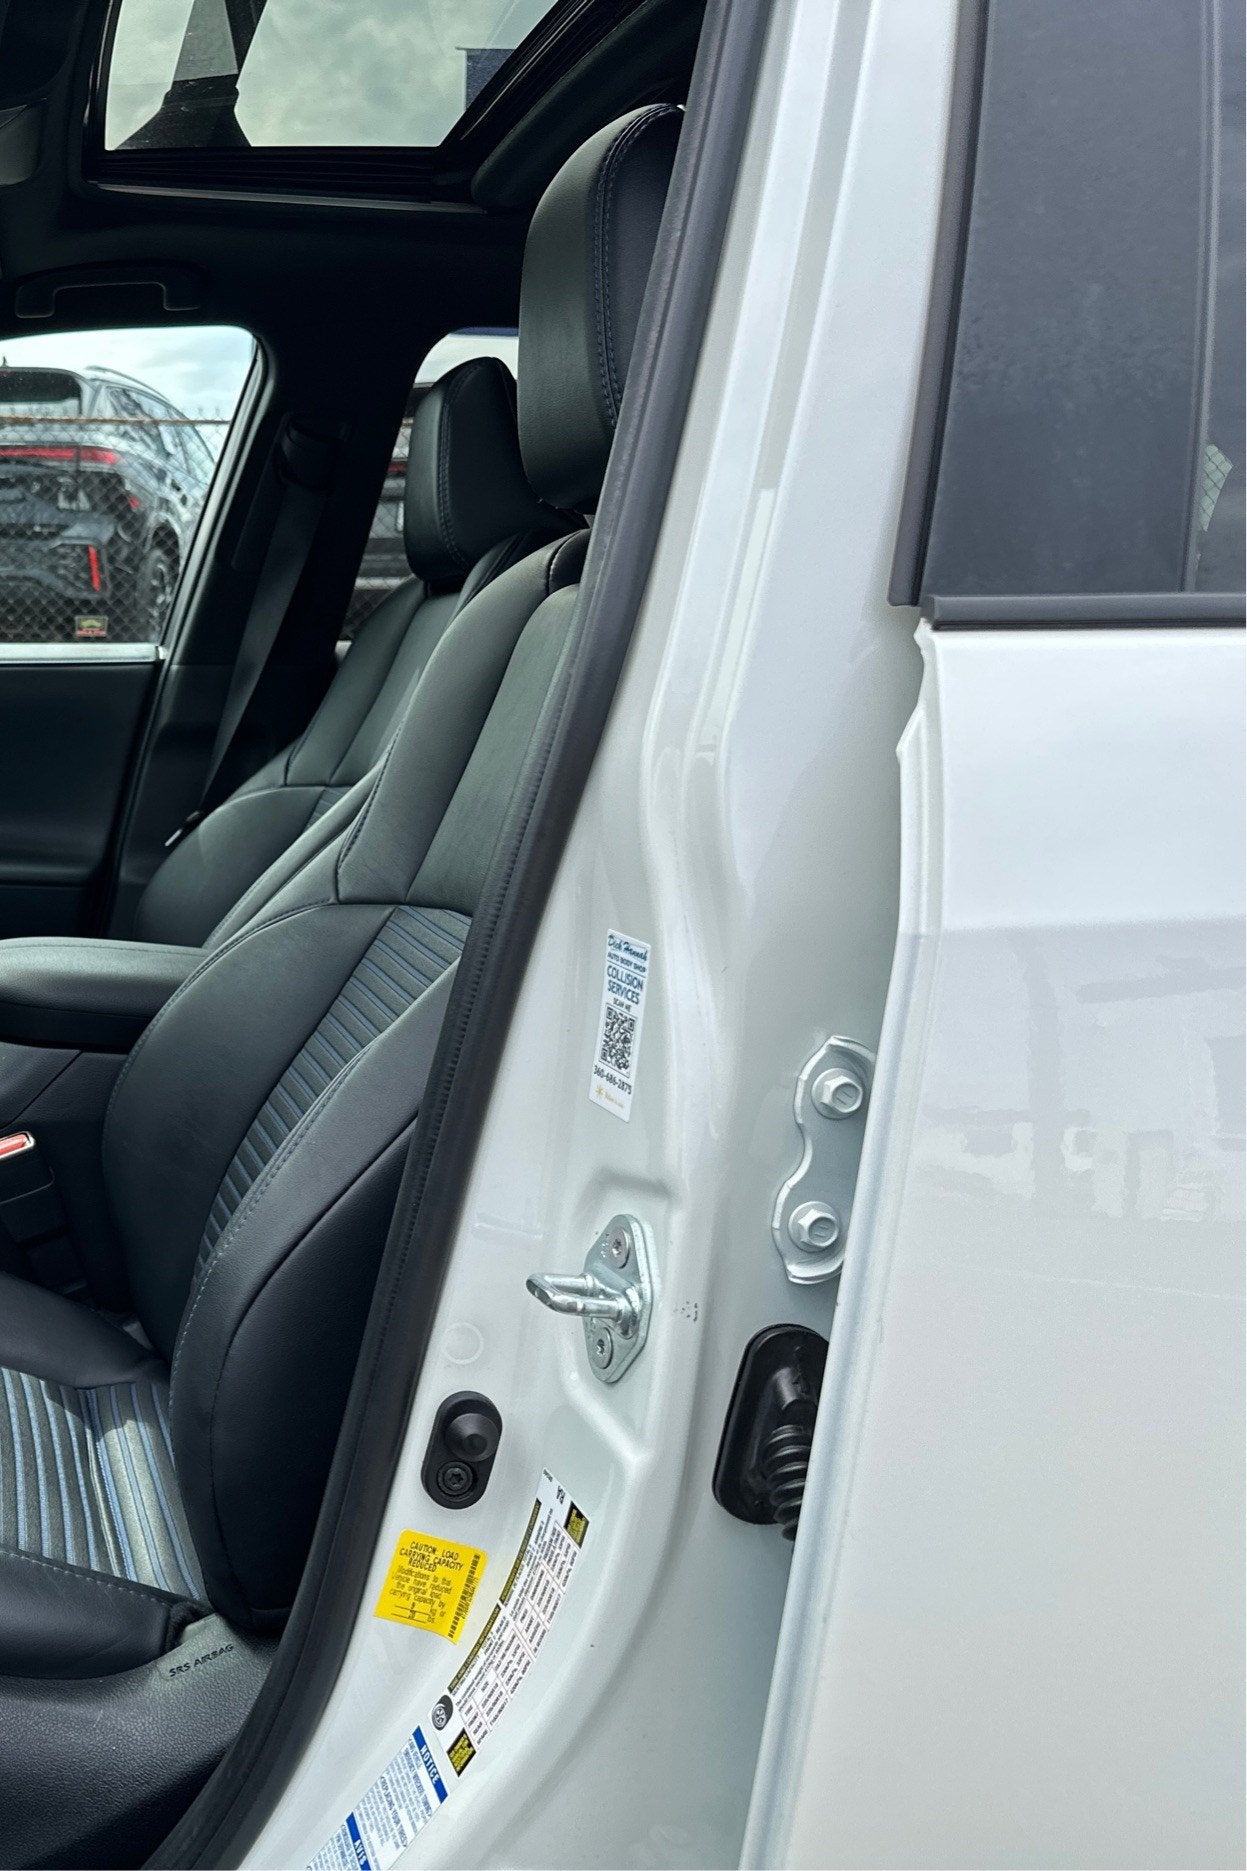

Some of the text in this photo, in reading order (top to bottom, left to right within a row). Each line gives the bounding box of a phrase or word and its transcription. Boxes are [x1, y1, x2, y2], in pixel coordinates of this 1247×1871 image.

[608, 934, 622, 950] Dick
[607, 951, 646, 973] AUTO BODY SHOP
[607, 965, 644, 992] COLLISION
[607, 979, 640, 1005] SERVICES
[399, 1548, 464, 1571] CARRYING CAPACITY
[408, 1558, 437, 1573] REDUCED
[442, 1549, 459, 1561] LOAD
[169, 1643, 234, 1677] SRS AIRBAG
[419, 1744, 441, 1785] NOTICE
[353, 1839, 367, 1866] AVIS
